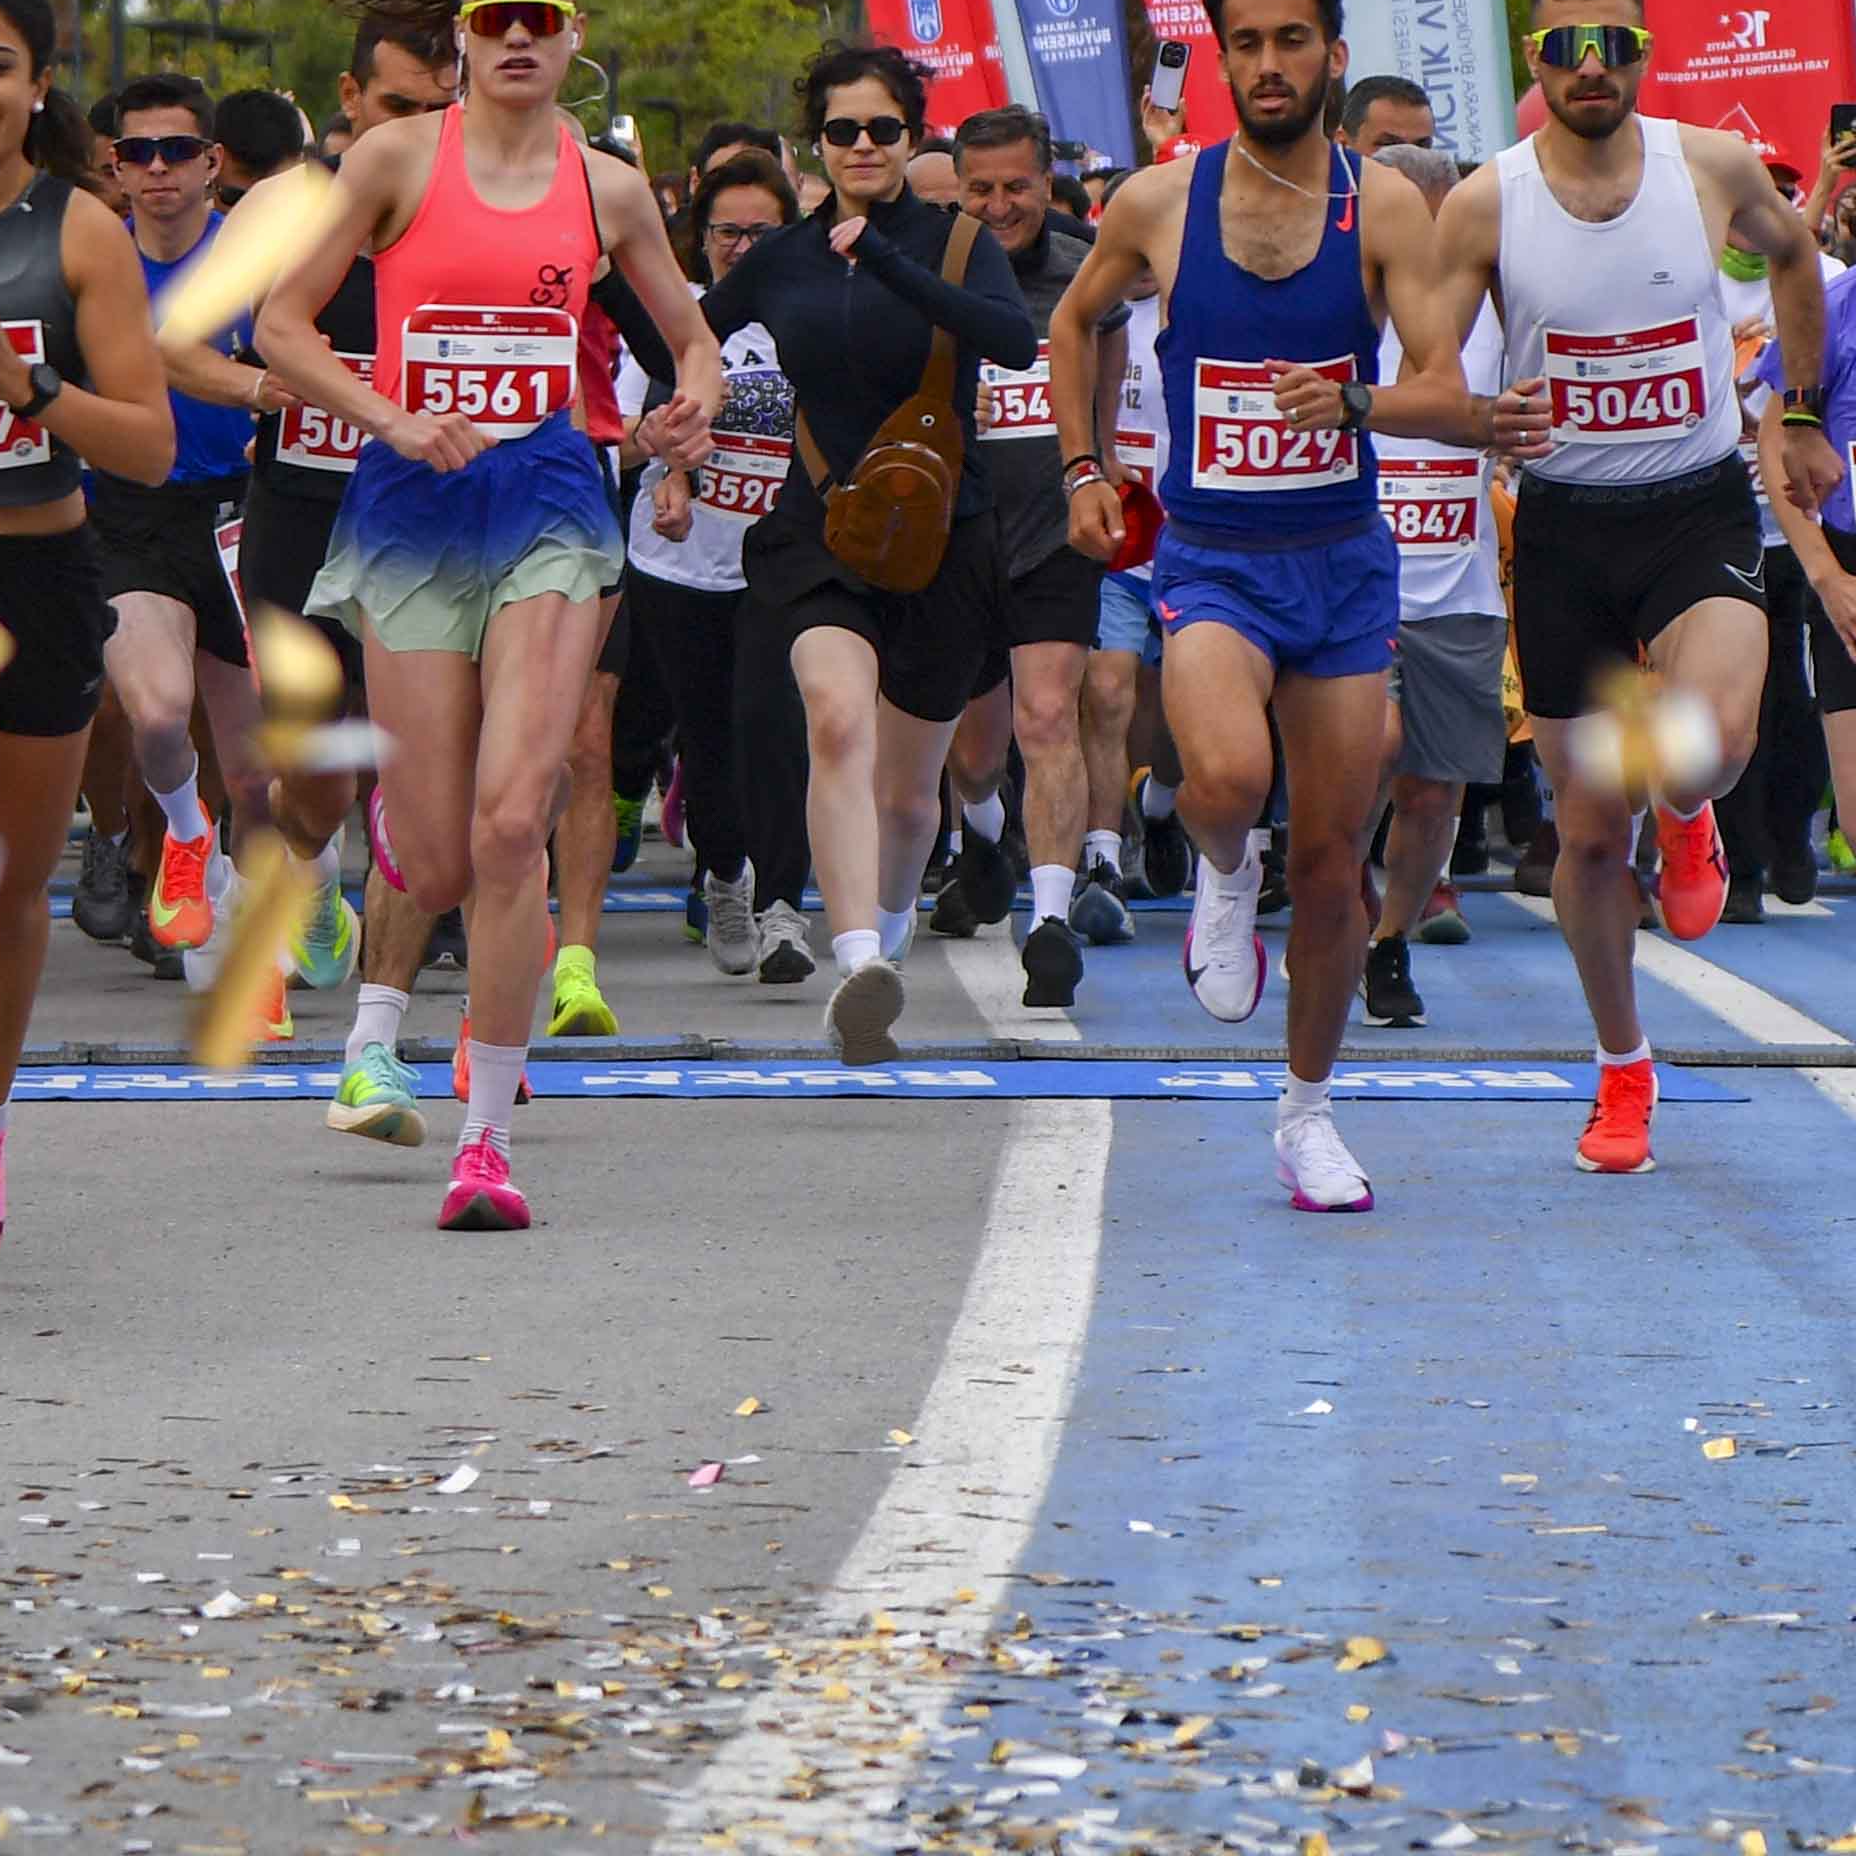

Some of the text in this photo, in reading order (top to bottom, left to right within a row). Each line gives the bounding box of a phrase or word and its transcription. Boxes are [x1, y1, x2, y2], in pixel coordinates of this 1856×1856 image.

[424, 368, 549, 416] 5561
[1566, 378, 1691, 425] 5040
[1215, 423, 1341, 469] 5029
[1378, 503, 1467, 538] 5847
